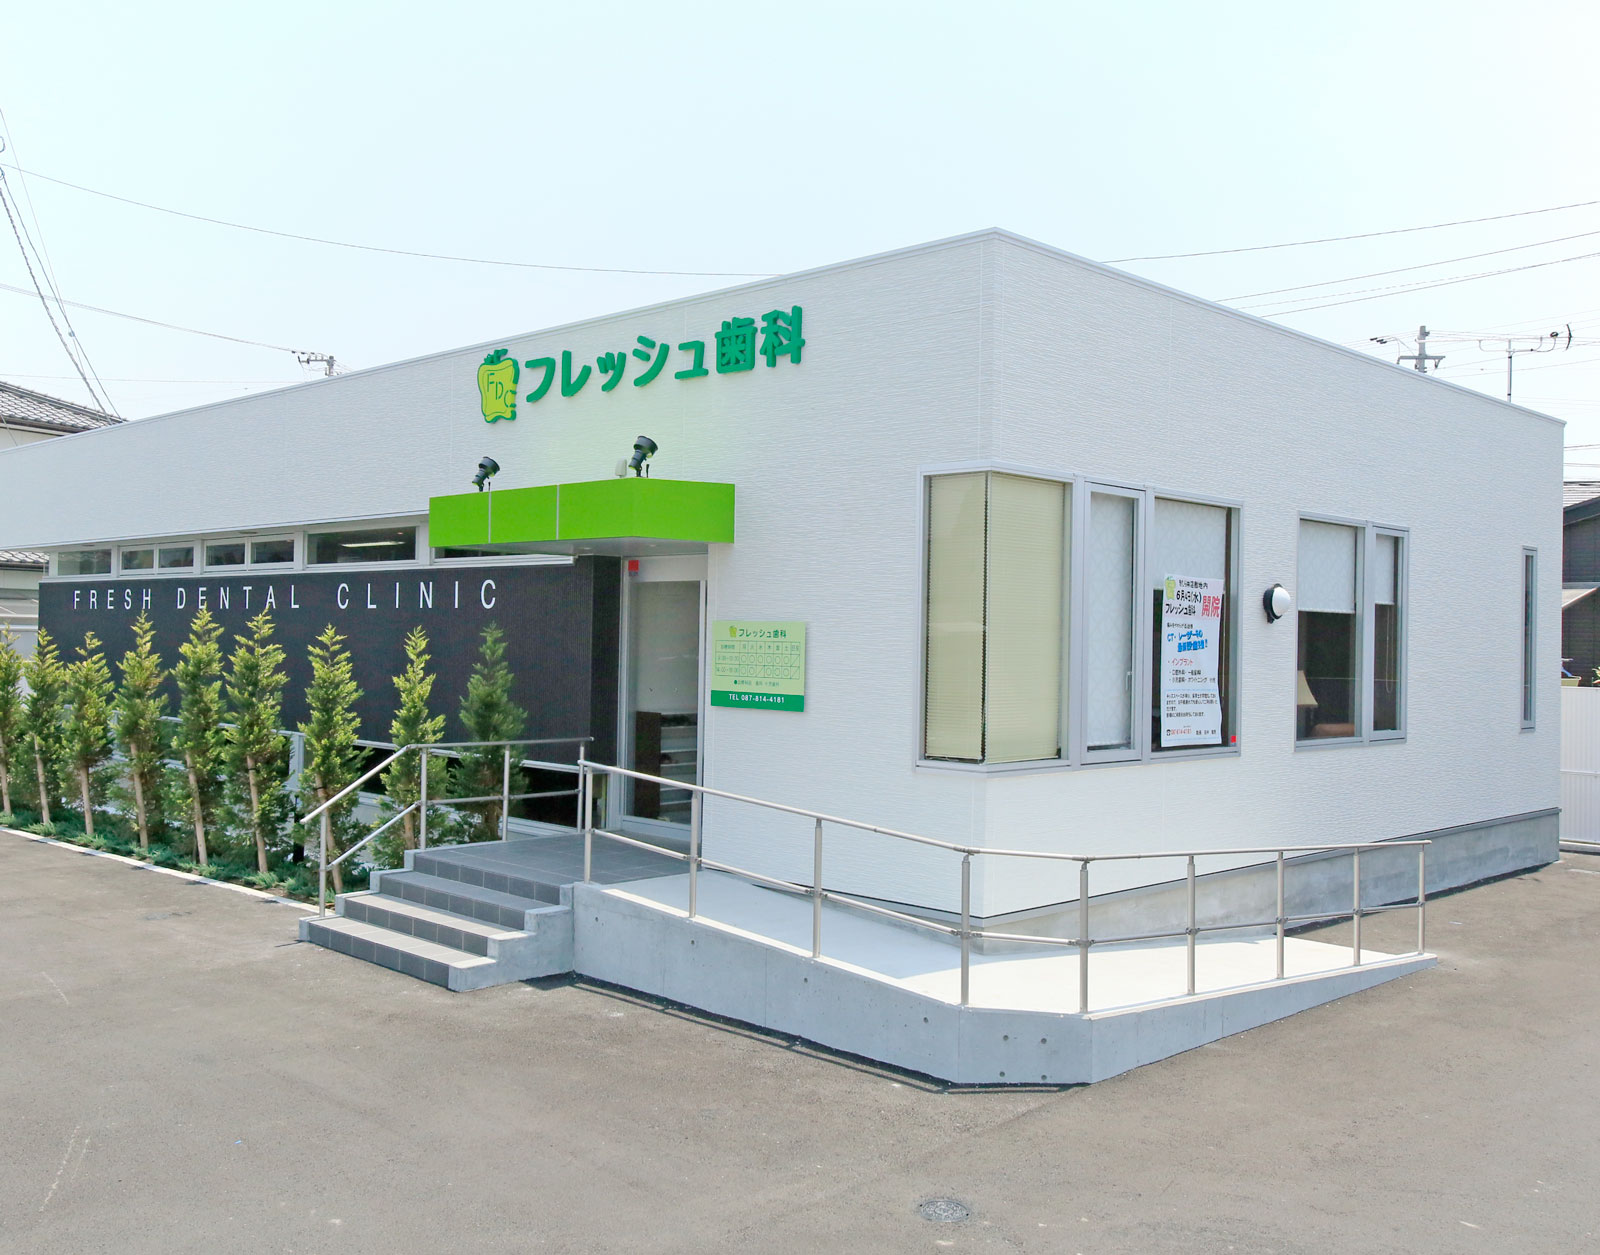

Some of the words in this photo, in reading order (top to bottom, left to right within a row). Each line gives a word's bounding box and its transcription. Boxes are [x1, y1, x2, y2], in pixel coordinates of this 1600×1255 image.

[524, 305, 806, 403] フレッシュ歯科
[73, 588, 151, 610] FRESH
[176, 584, 300, 610] DENTAL
[336, 579, 497, 610] CLINIC
[1201, 595, 1221, 617] 開院
[738, 628, 787, 639] フレッシュ歯科
[728, 693, 740, 701] TEL
[741, 694, 785, 704] 087-814-4181
